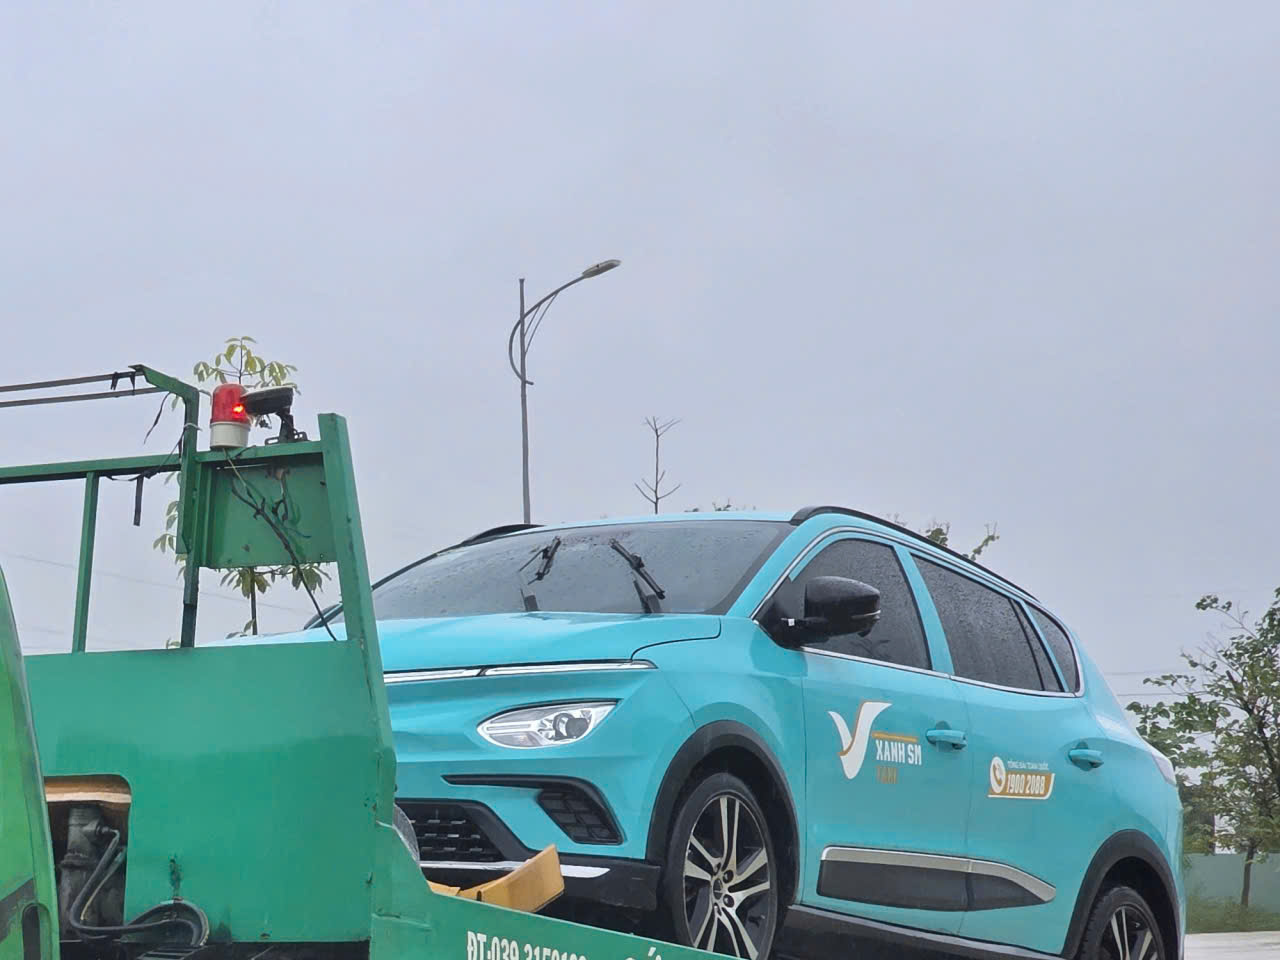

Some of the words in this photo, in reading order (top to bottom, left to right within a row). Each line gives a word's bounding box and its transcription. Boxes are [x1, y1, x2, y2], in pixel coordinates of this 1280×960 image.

[876, 740, 905, 764] XANH
[908, 743, 922, 766] SM
[1007, 774, 1025, 794] 1900
